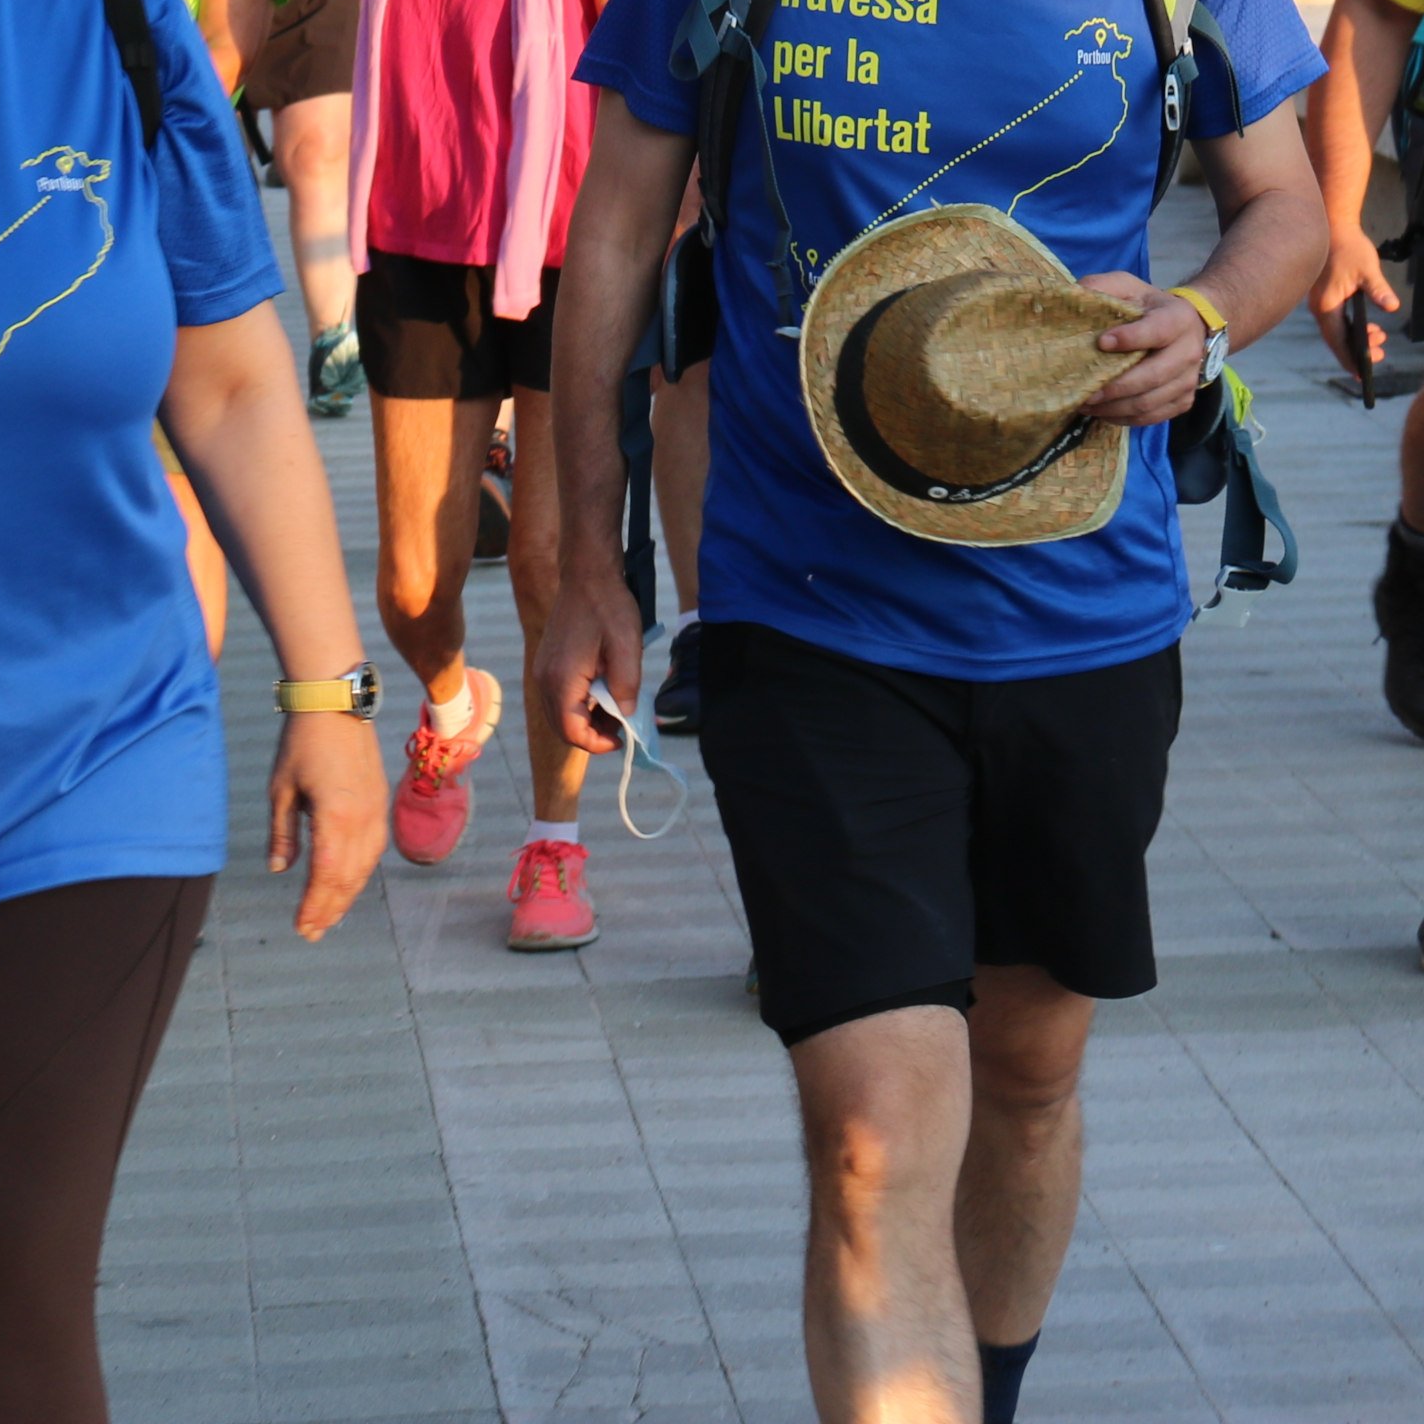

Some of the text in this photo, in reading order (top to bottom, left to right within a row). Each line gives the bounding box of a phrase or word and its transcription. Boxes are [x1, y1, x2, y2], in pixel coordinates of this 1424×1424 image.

[772, 37, 880, 85] per la
[1077, 48, 1112, 65] Portbou
[773, 95, 931, 154] Llibertat
